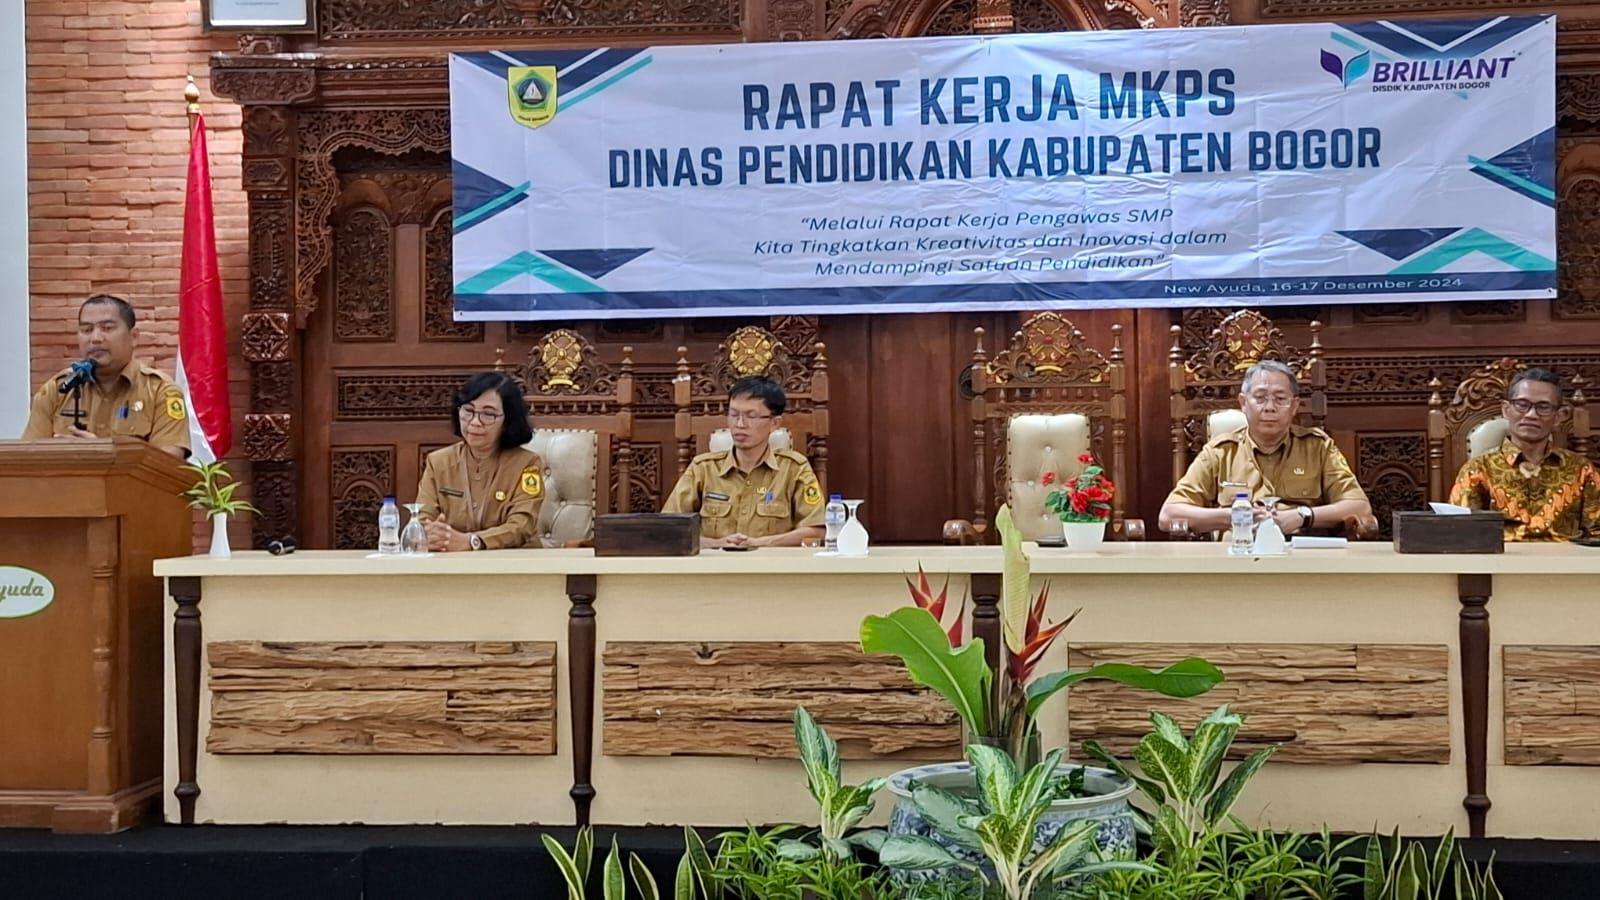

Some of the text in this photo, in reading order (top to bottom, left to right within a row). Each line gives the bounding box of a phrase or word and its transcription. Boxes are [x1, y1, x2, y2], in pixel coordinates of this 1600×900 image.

[1372, 57, 1516, 83] BRILLIANT
[743, 68, 1235, 130] RAPAT KERJA MKPS
[1372, 81, 1491, 93] DISDIK KABUPATEN BOGOR
[609, 127, 1381, 188] DINAS PENDIDIKAN KABUPATEN BOGOR
[889, 214, 951, 231] Rapat
[957, 212, 1009, 229] Kerja
[1015, 210, 1120, 228] Pengawas
[1127, 208, 1173, 223] SMP
[754, 230, 1227, 256] Kita Tingkatkan Kreativitas dan Inovasi dalam
[815, 260, 953, 277] Mendampingi
[958, 257, 1032, 272] Satuan
[1164, 278, 1463, 294] New Ayuda, 16-17 Desember 2024
